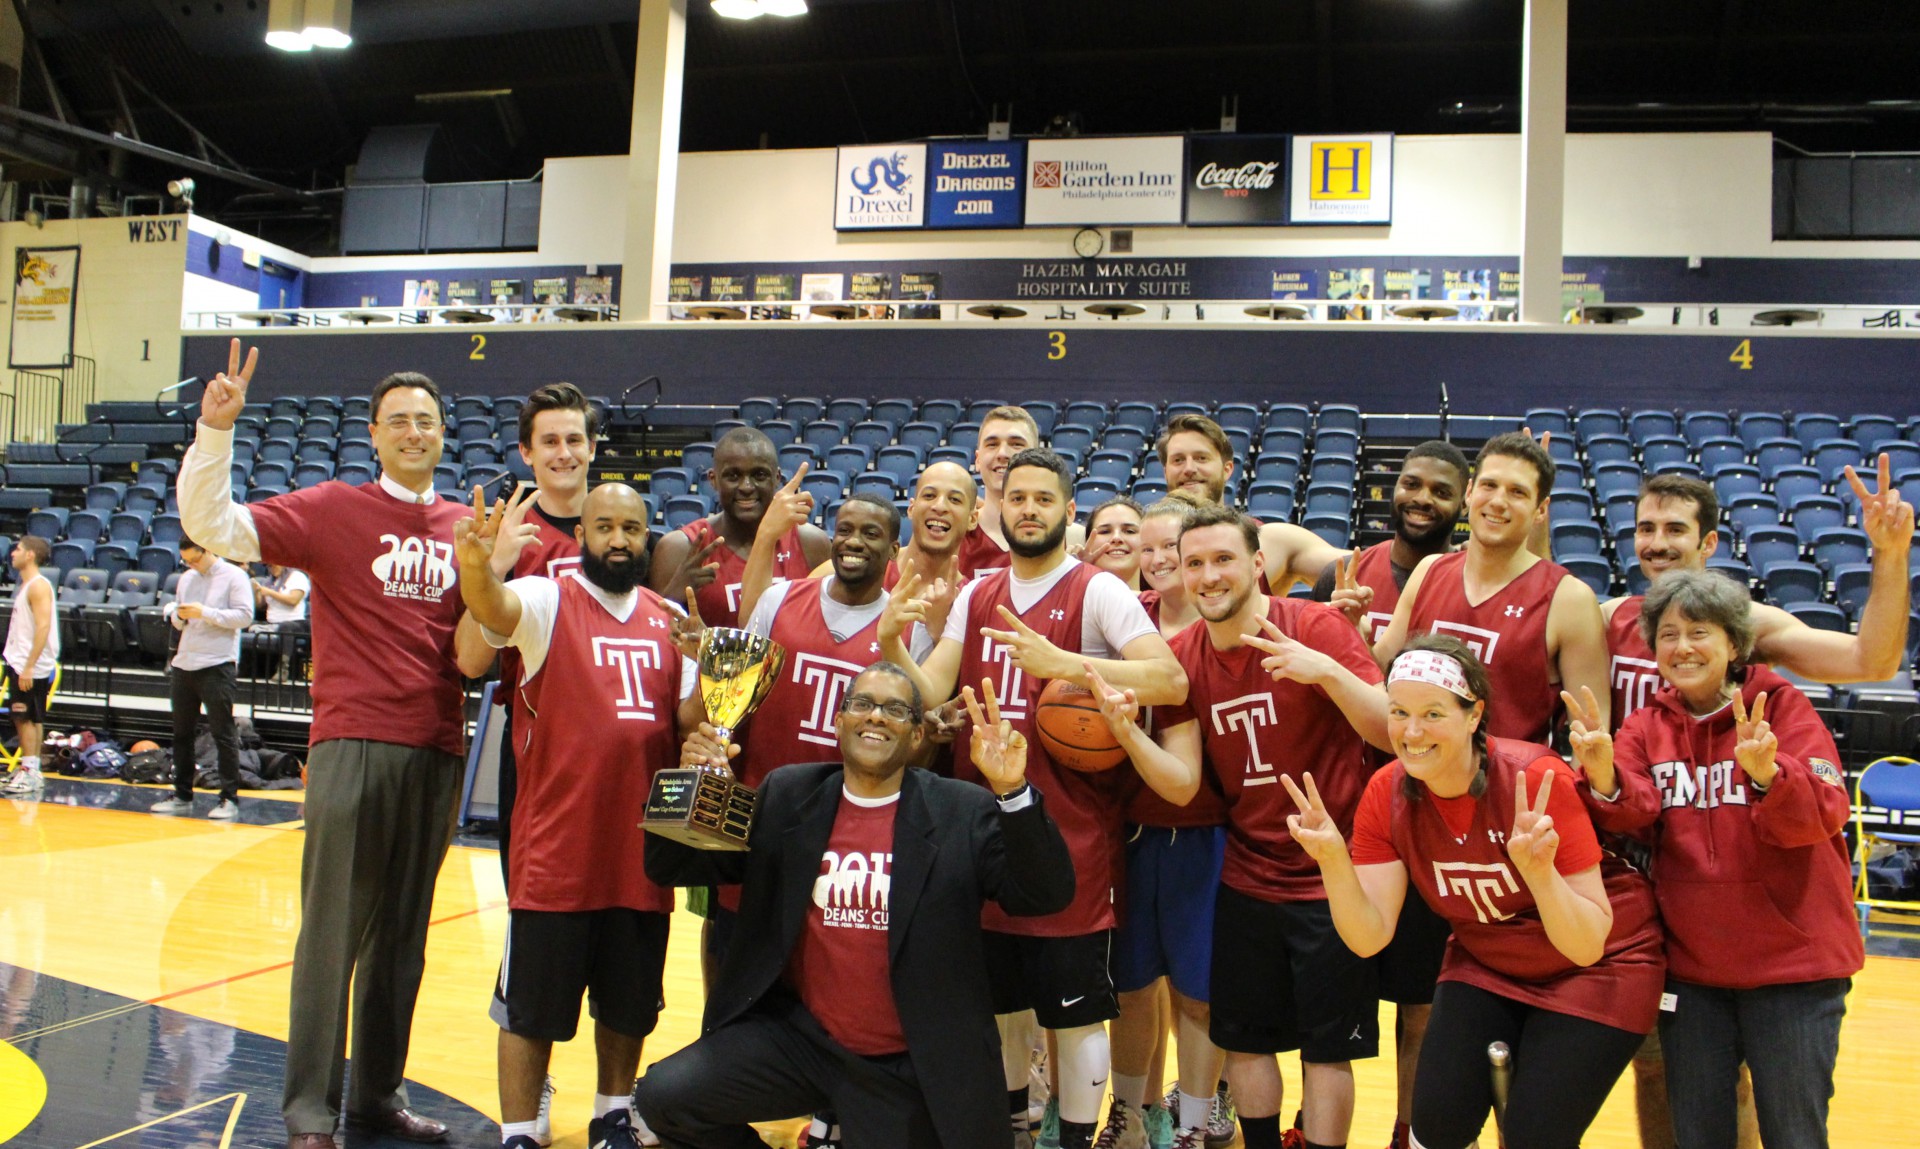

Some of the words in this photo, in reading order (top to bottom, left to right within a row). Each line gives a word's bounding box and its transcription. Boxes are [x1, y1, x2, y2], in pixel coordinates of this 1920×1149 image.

[942, 152, 1010, 169] DREXEL
[1065, 160, 1107, 171] Hilton
[1317, 147, 1365, 194] H
[936, 175, 1015, 192] DRAGONS
[1062, 172, 1133, 188] Garden
[1139, 171, 1173, 186] Inn
[1062, 190, 1123, 200] Philadelphia
[1125, 189, 1155, 198] Center
[1158, 188, 1177, 199] City
[1223, 189, 1249, 198] zero
[849, 193, 913, 214] Drexel
[1310, 202, 1370, 211] Hahnemann
[850, 214, 913, 223] MEDICINE
[128, 219, 182, 243] WEST
[1023, 264, 1085, 277] HAZEM
[1096, 263, 1187, 277] MARAGAH
[1017, 282, 1129, 296] HOSPITALITY
[1138, 281, 1191, 295] SUITE
[140, 340, 151, 361] 1
[470, 334, 486, 360] 2
[1047, 331, 1067, 360] 3
[1729, 339, 1753, 369] 4
[383, 580, 422, 594] DEANS'
[424, 585, 443, 598] CUP
[591, 637, 660, 720] T
[1211, 692, 1278, 787] T
[813, 851, 893, 909] 201
[824, 907, 869, 923] DEANS'
[871, 911, 889, 924] CU
